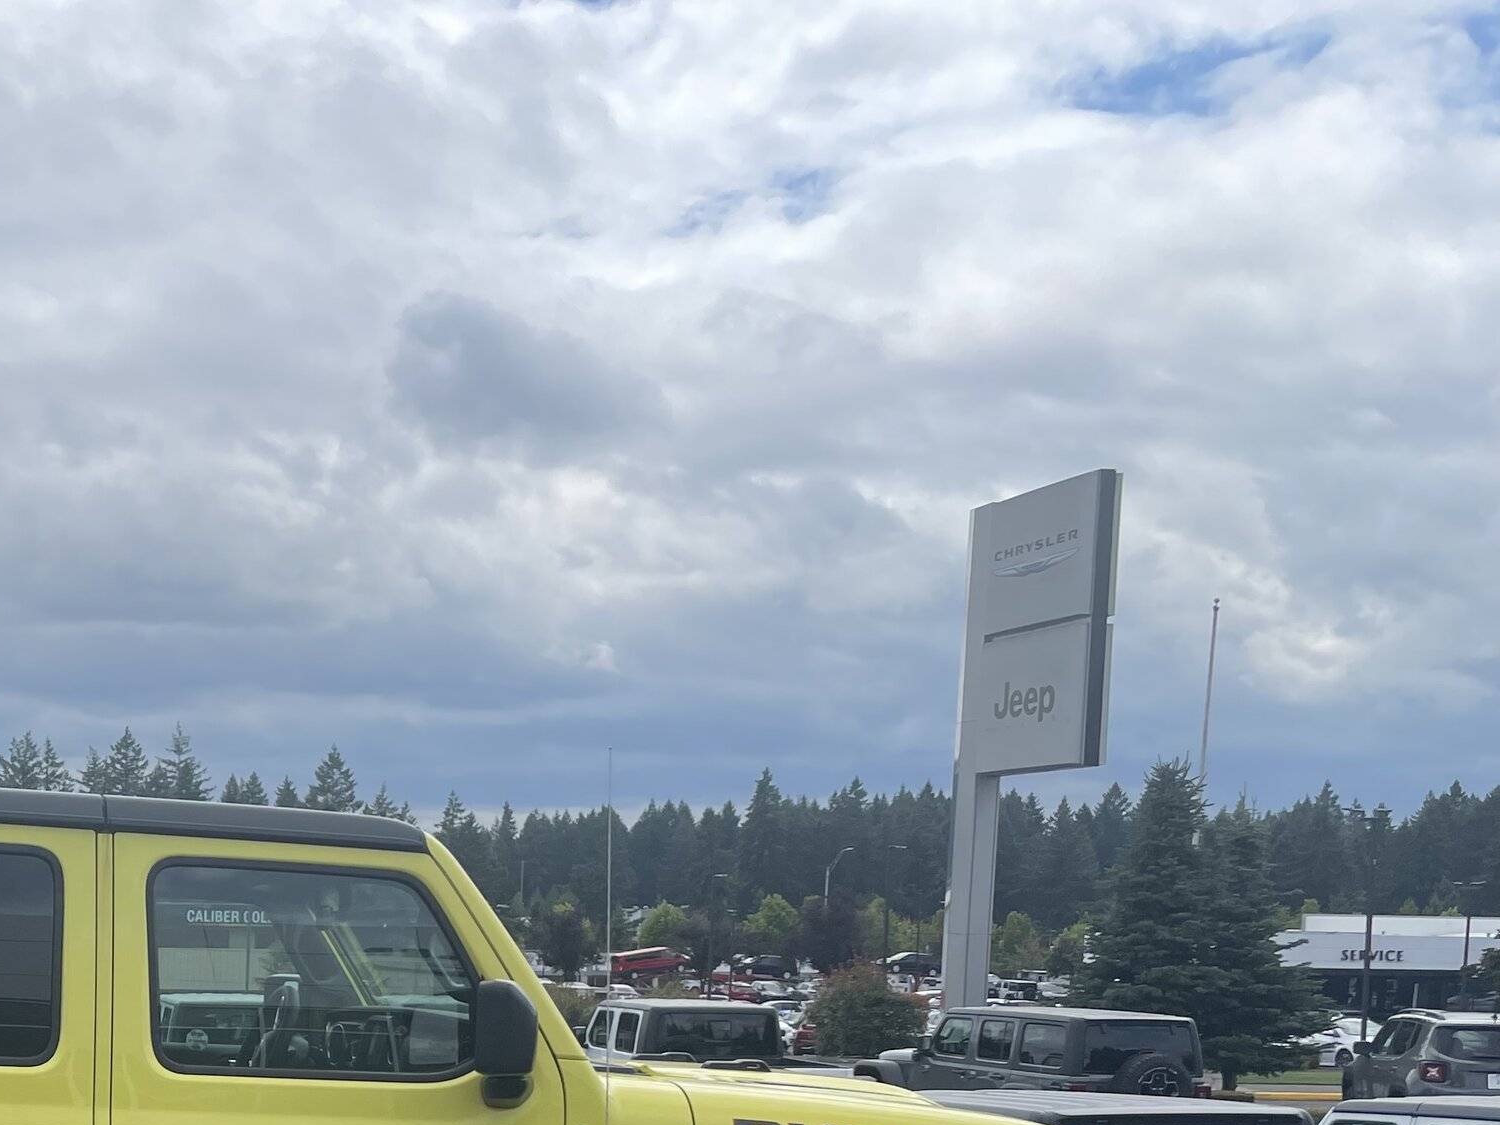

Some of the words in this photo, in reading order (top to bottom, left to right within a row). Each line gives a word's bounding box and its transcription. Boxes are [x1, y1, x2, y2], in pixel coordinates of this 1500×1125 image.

[994, 529, 1079, 562] CHRYSLER
[994, 681, 1056, 723] Jeep
[186, 909, 240, 923] CALIBER
